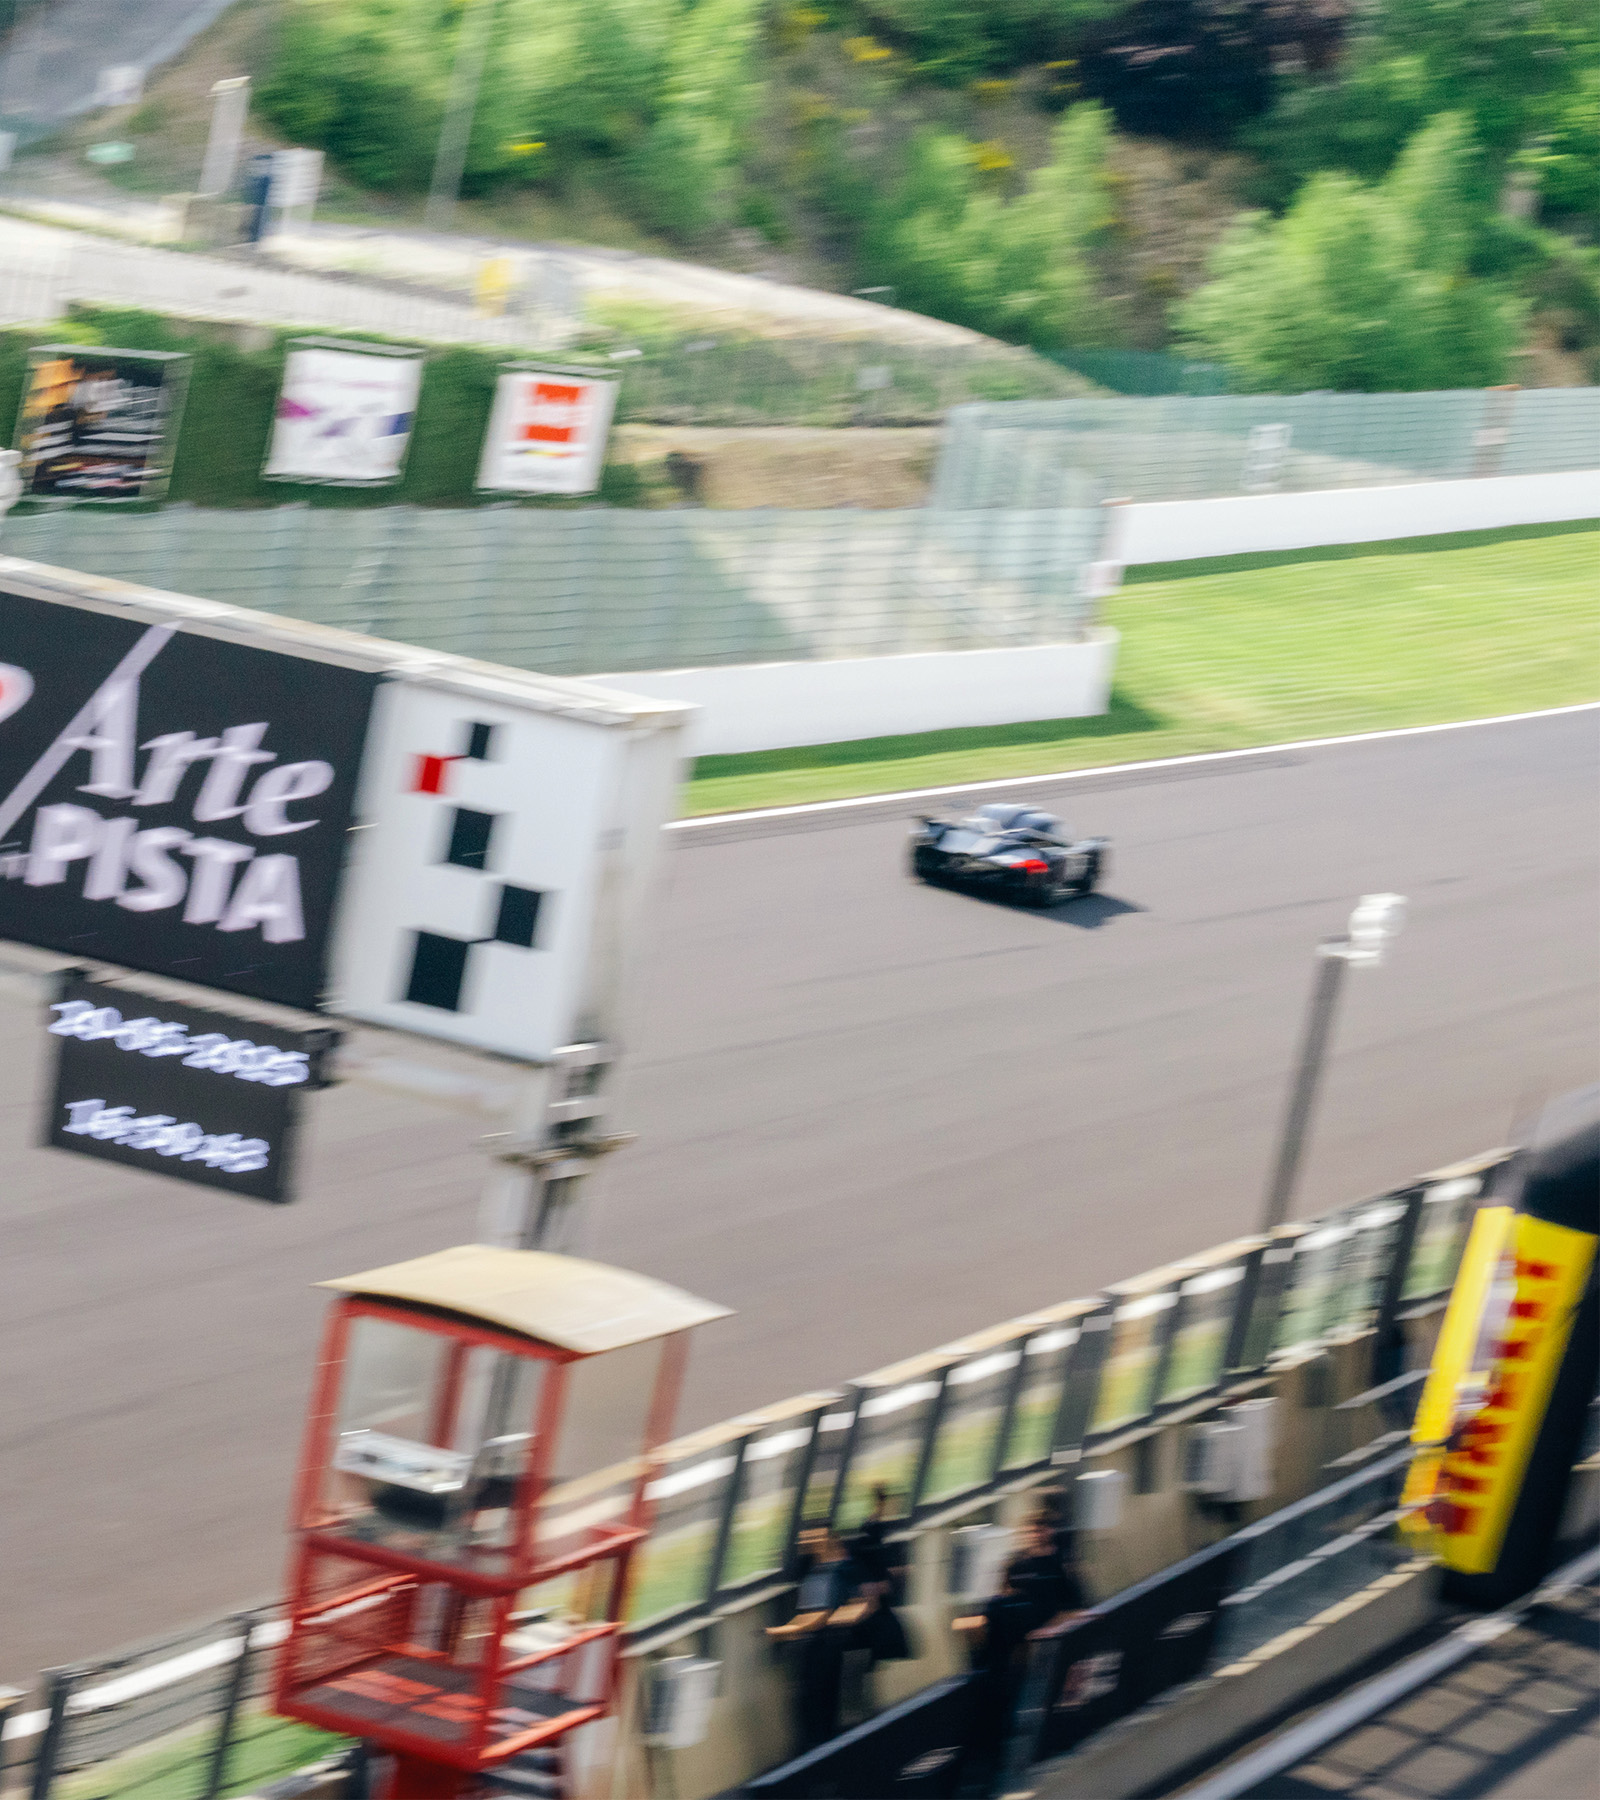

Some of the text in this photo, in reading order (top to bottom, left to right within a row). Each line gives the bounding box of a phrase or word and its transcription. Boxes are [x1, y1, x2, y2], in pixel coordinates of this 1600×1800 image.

[60, 674, 335, 836] Arte
[24, 803, 304, 943] PISTA
[48, 1000, 310, 1087] 20-05-2025
